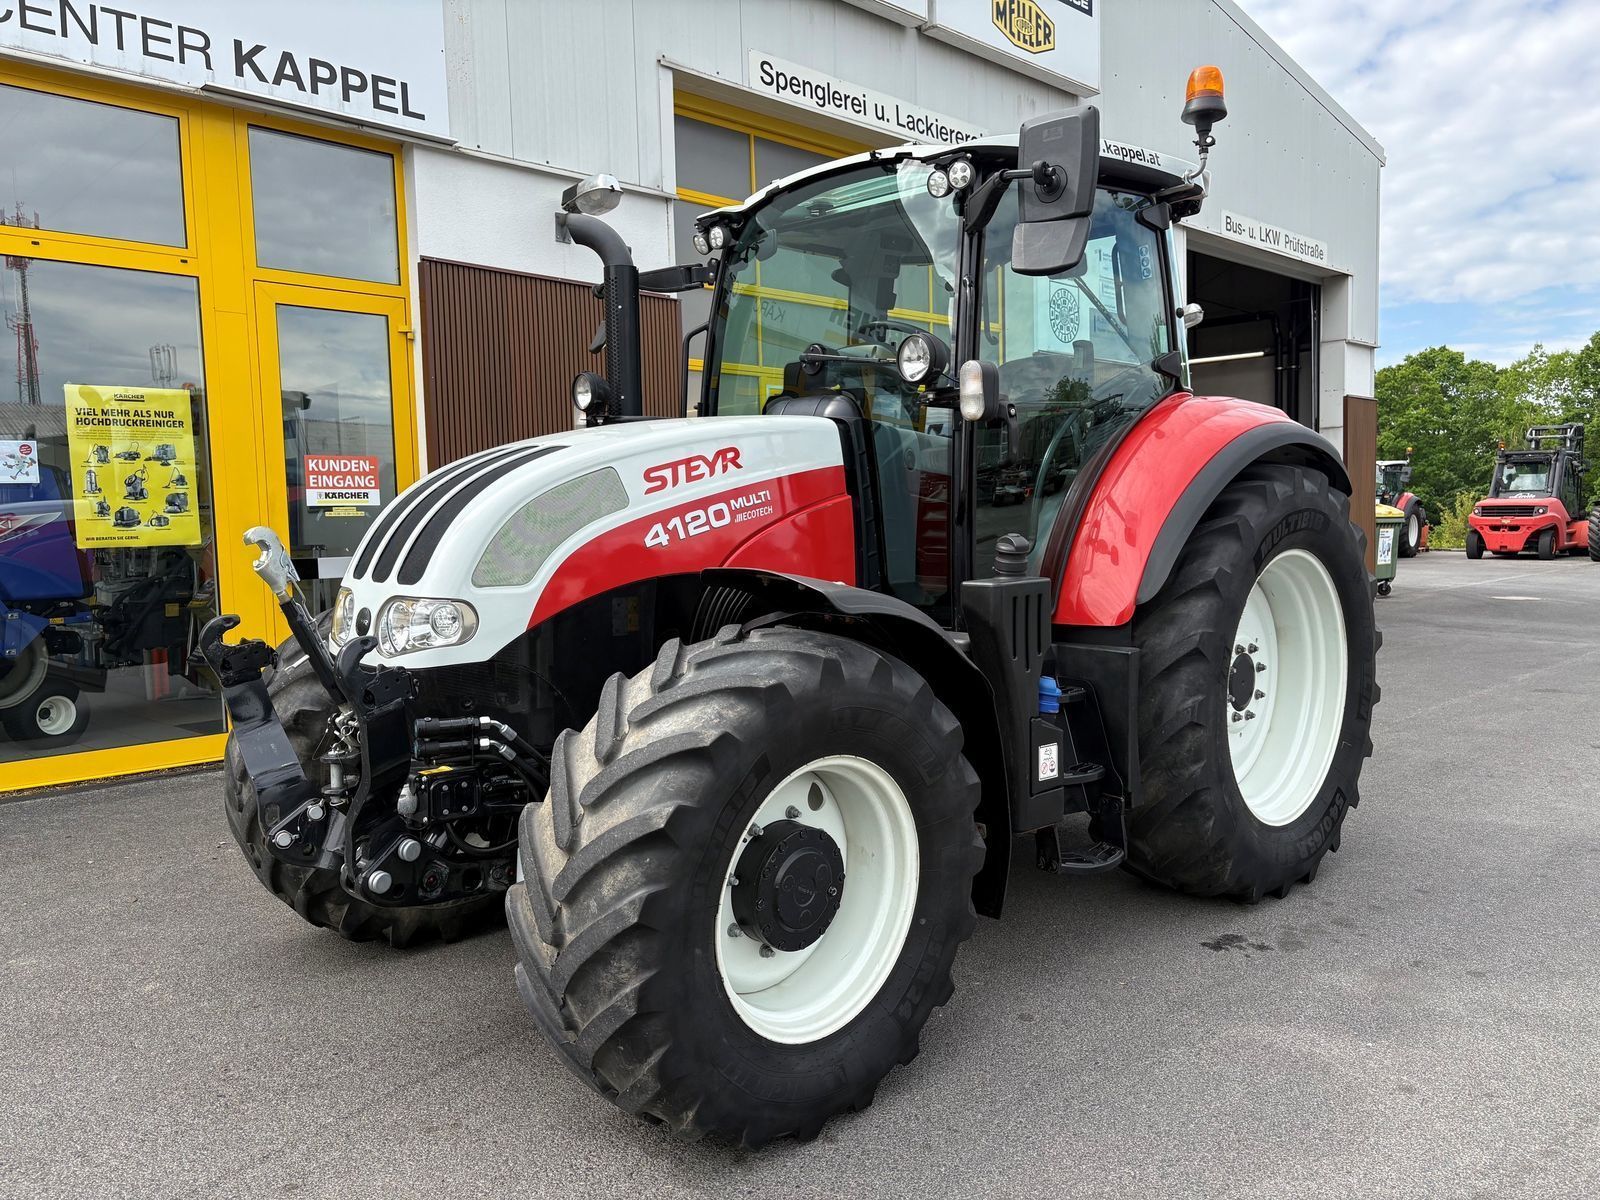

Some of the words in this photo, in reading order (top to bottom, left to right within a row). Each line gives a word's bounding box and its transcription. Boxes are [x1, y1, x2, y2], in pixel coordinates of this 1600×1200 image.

[995, 0, 1052, 48] MEILLER
[0, 0, 213, 71] ENTER
[233, 38, 426, 121] KAPPEL
[759, 60, 867, 116] Spenglerei
[874, 103, 890, 123] u.
[895, 104, 983, 145] Lackierer
[1225, 216, 1245, 235] Bus-
[1248, 226, 1256, 239] u.
[1259, 226, 1280, 246] LKW
[1284, 234, 1324, 260] Prüfstraße
[75, 407, 98, 416] VIEL
[101, 408, 130, 417] MEHR
[133, 409, 151, 418] ALS
[154, 410, 174, 418] NUR
[76, 417, 184, 428] HOCHDRUCKREINIGER
[308, 459, 375, 472] KUNDEN-
[643, 446, 743, 495] STEYR
[309, 474, 375, 488] EINGANG
[324, 491, 369, 500] KÄRCHER
[643, 502, 731, 548] 4120
[730, 490, 771, 511] MULTI
[743, 505, 773, 520] ECOTECH
